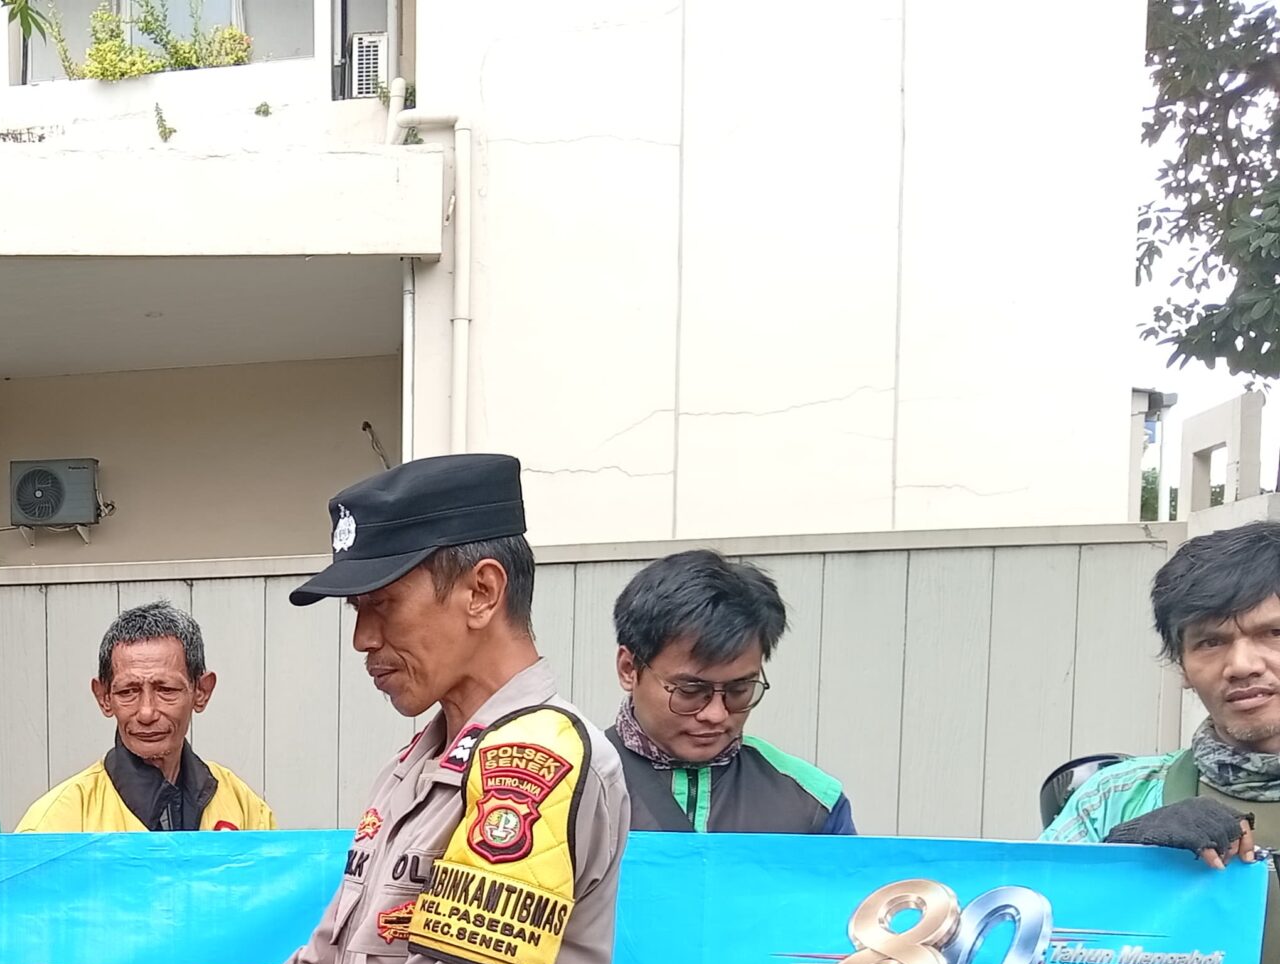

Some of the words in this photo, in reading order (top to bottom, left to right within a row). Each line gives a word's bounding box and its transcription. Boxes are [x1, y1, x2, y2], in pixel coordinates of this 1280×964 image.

[485, 758, 555, 781] SENEN
[486, 746, 560, 773] POLSEK
[487, 777, 519, 787] METRO
